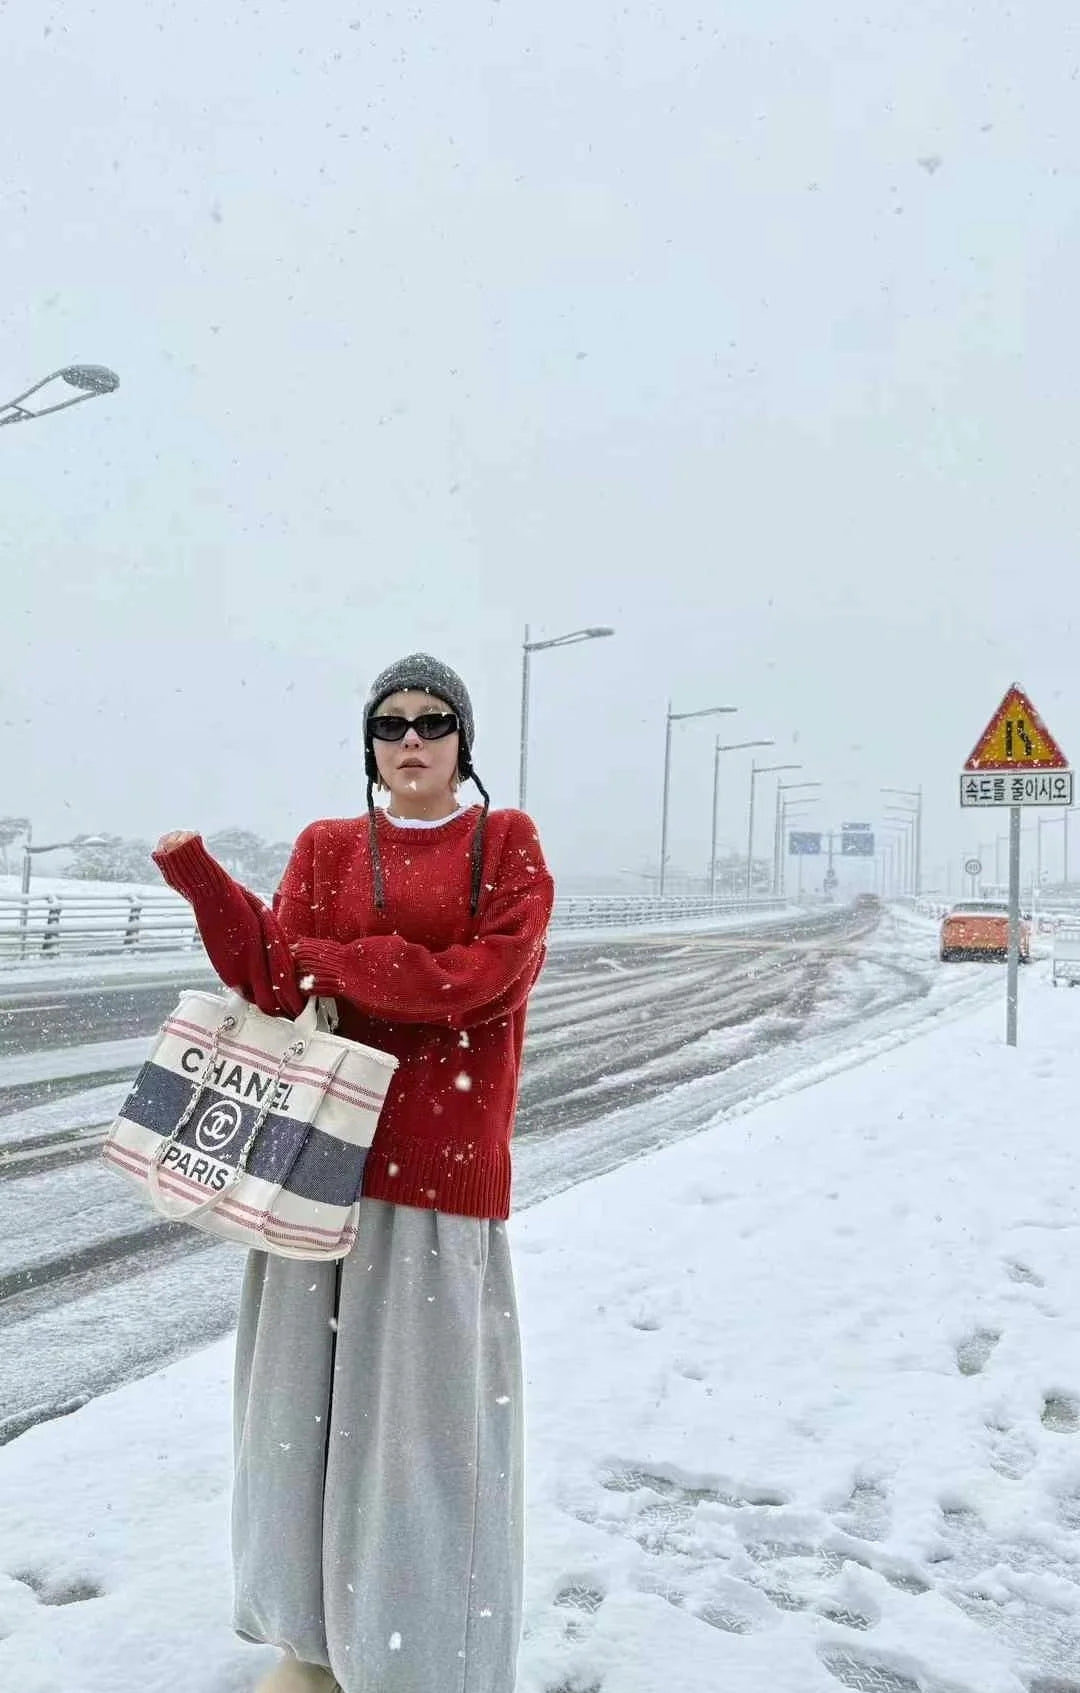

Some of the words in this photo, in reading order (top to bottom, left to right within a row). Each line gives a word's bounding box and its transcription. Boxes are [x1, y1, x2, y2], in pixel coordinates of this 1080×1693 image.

[965, 777, 1005, 801] 속도를
[1011, 777, 1067, 801] 줄이시오
[162, 1147, 229, 1191] PARIS
